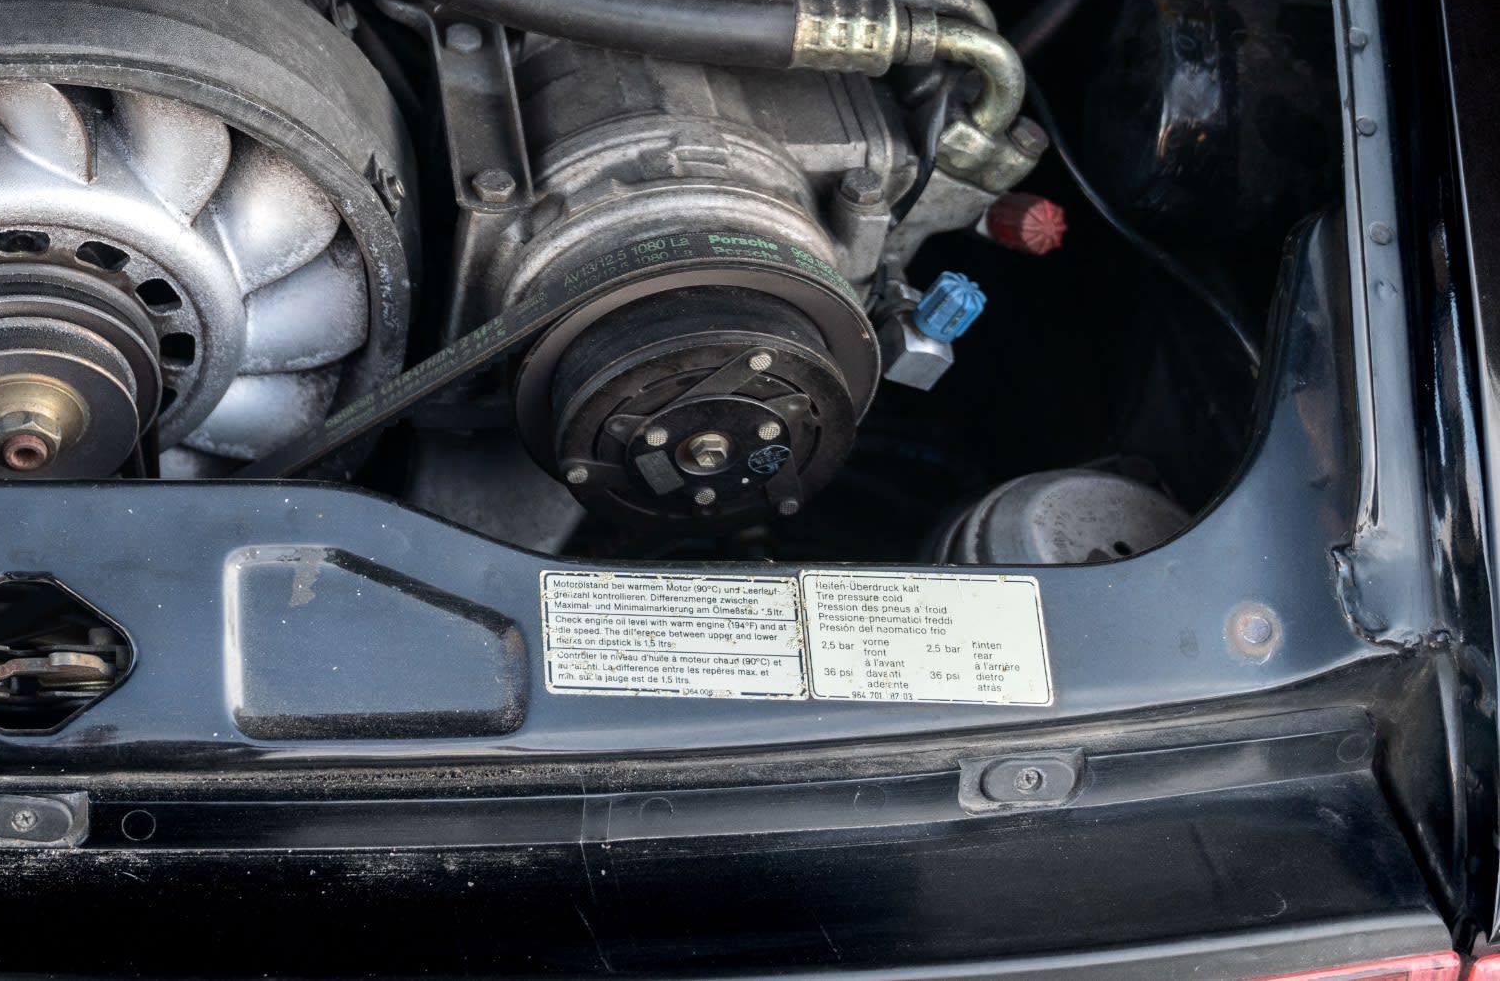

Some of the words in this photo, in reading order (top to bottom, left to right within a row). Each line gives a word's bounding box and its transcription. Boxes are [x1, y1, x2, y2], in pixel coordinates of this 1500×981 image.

[631, 239, 666, 255] 1080
[708, 234, 779, 251] Porsche
[612, 582, 625, 590] bei
[666, 582, 692, 592] Motor
[724, 586, 741, 595] und
[902, 584, 920, 593] kalt
[650, 593, 717, 604] Differenzmenge
[720, 596, 759, 605] zwischen
[816, 591, 835, 601] Tire
[837, 594, 879, 603] pressure
[882, 594, 903, 603] cold
[554, 601, 592, 610] Maximal-
[595, 603, 611, 611] und
[614, 603, 694, 615] Minimalmarkierung
[817, 602, 858, 612] Pression
[861, 604, 879, 613] des
[881, 606, 911, 614] pneus
[925, 605, 948, 615] froid
[555, 615, 582, 624] Check
[585, 617, 613, 626] engine
[650, 619, 668, 627] with
[696, 621, 725, 630] engine
[760, 623, 776, 631] and
[778, 623, 787, 631] at
[924, 616, 953, 625] freddi
[605, 627, 621, 636] The
[668, 630, 706, 639] between
[708, 633, 733, 641] upper
[735, 632, 752, 641] and
[754, 633, 778, 642] lower
[858, 624, 873, 633] del
[930, 626, 947, 636] frio
[598, 638, 632, 648] dipstick
[634, 640, 642, 648] is
[821, 641, 836, 651] 2,5
[839, 640, 855, 651] bar
[862, 639, 890, 647] vorne
[944, 644, 961, 654] bar
[863, 648, 887, 657] front
[973, 652, 993, 660] rear
[600, 653, 608, 661] le
[610, 654, 639, 662] niveau
[641, 653, 669, 662] d'huile
[679, 656, 711, 664] moteur
[773, 659, 783, 667] et
[874, 658, 905, 668] l'avant
[602, 663, 615, 672] La
[662, 666, 685, 674] entre
[687, 666, 700, 674] les
[738, 669, 759, 677] max.
[761, 669, 770, 677] et
[823, 667, 837, 677] 36
[839, 669, 854, 679] psi
[930, 670, 943, 680] 36
[946, 672, 960, 682] psi
[594, 673, 603, 682] la
[604, 674, 630, 684] jauge
[631, 675, 645, 683] est
[647, 675, 659, 684] de
[975, 672, 1005, 682] dietro
[851, 690, 866, 700] 964
[869, 691, 883, 700] 701
[902, 692, 913, 701] 03
